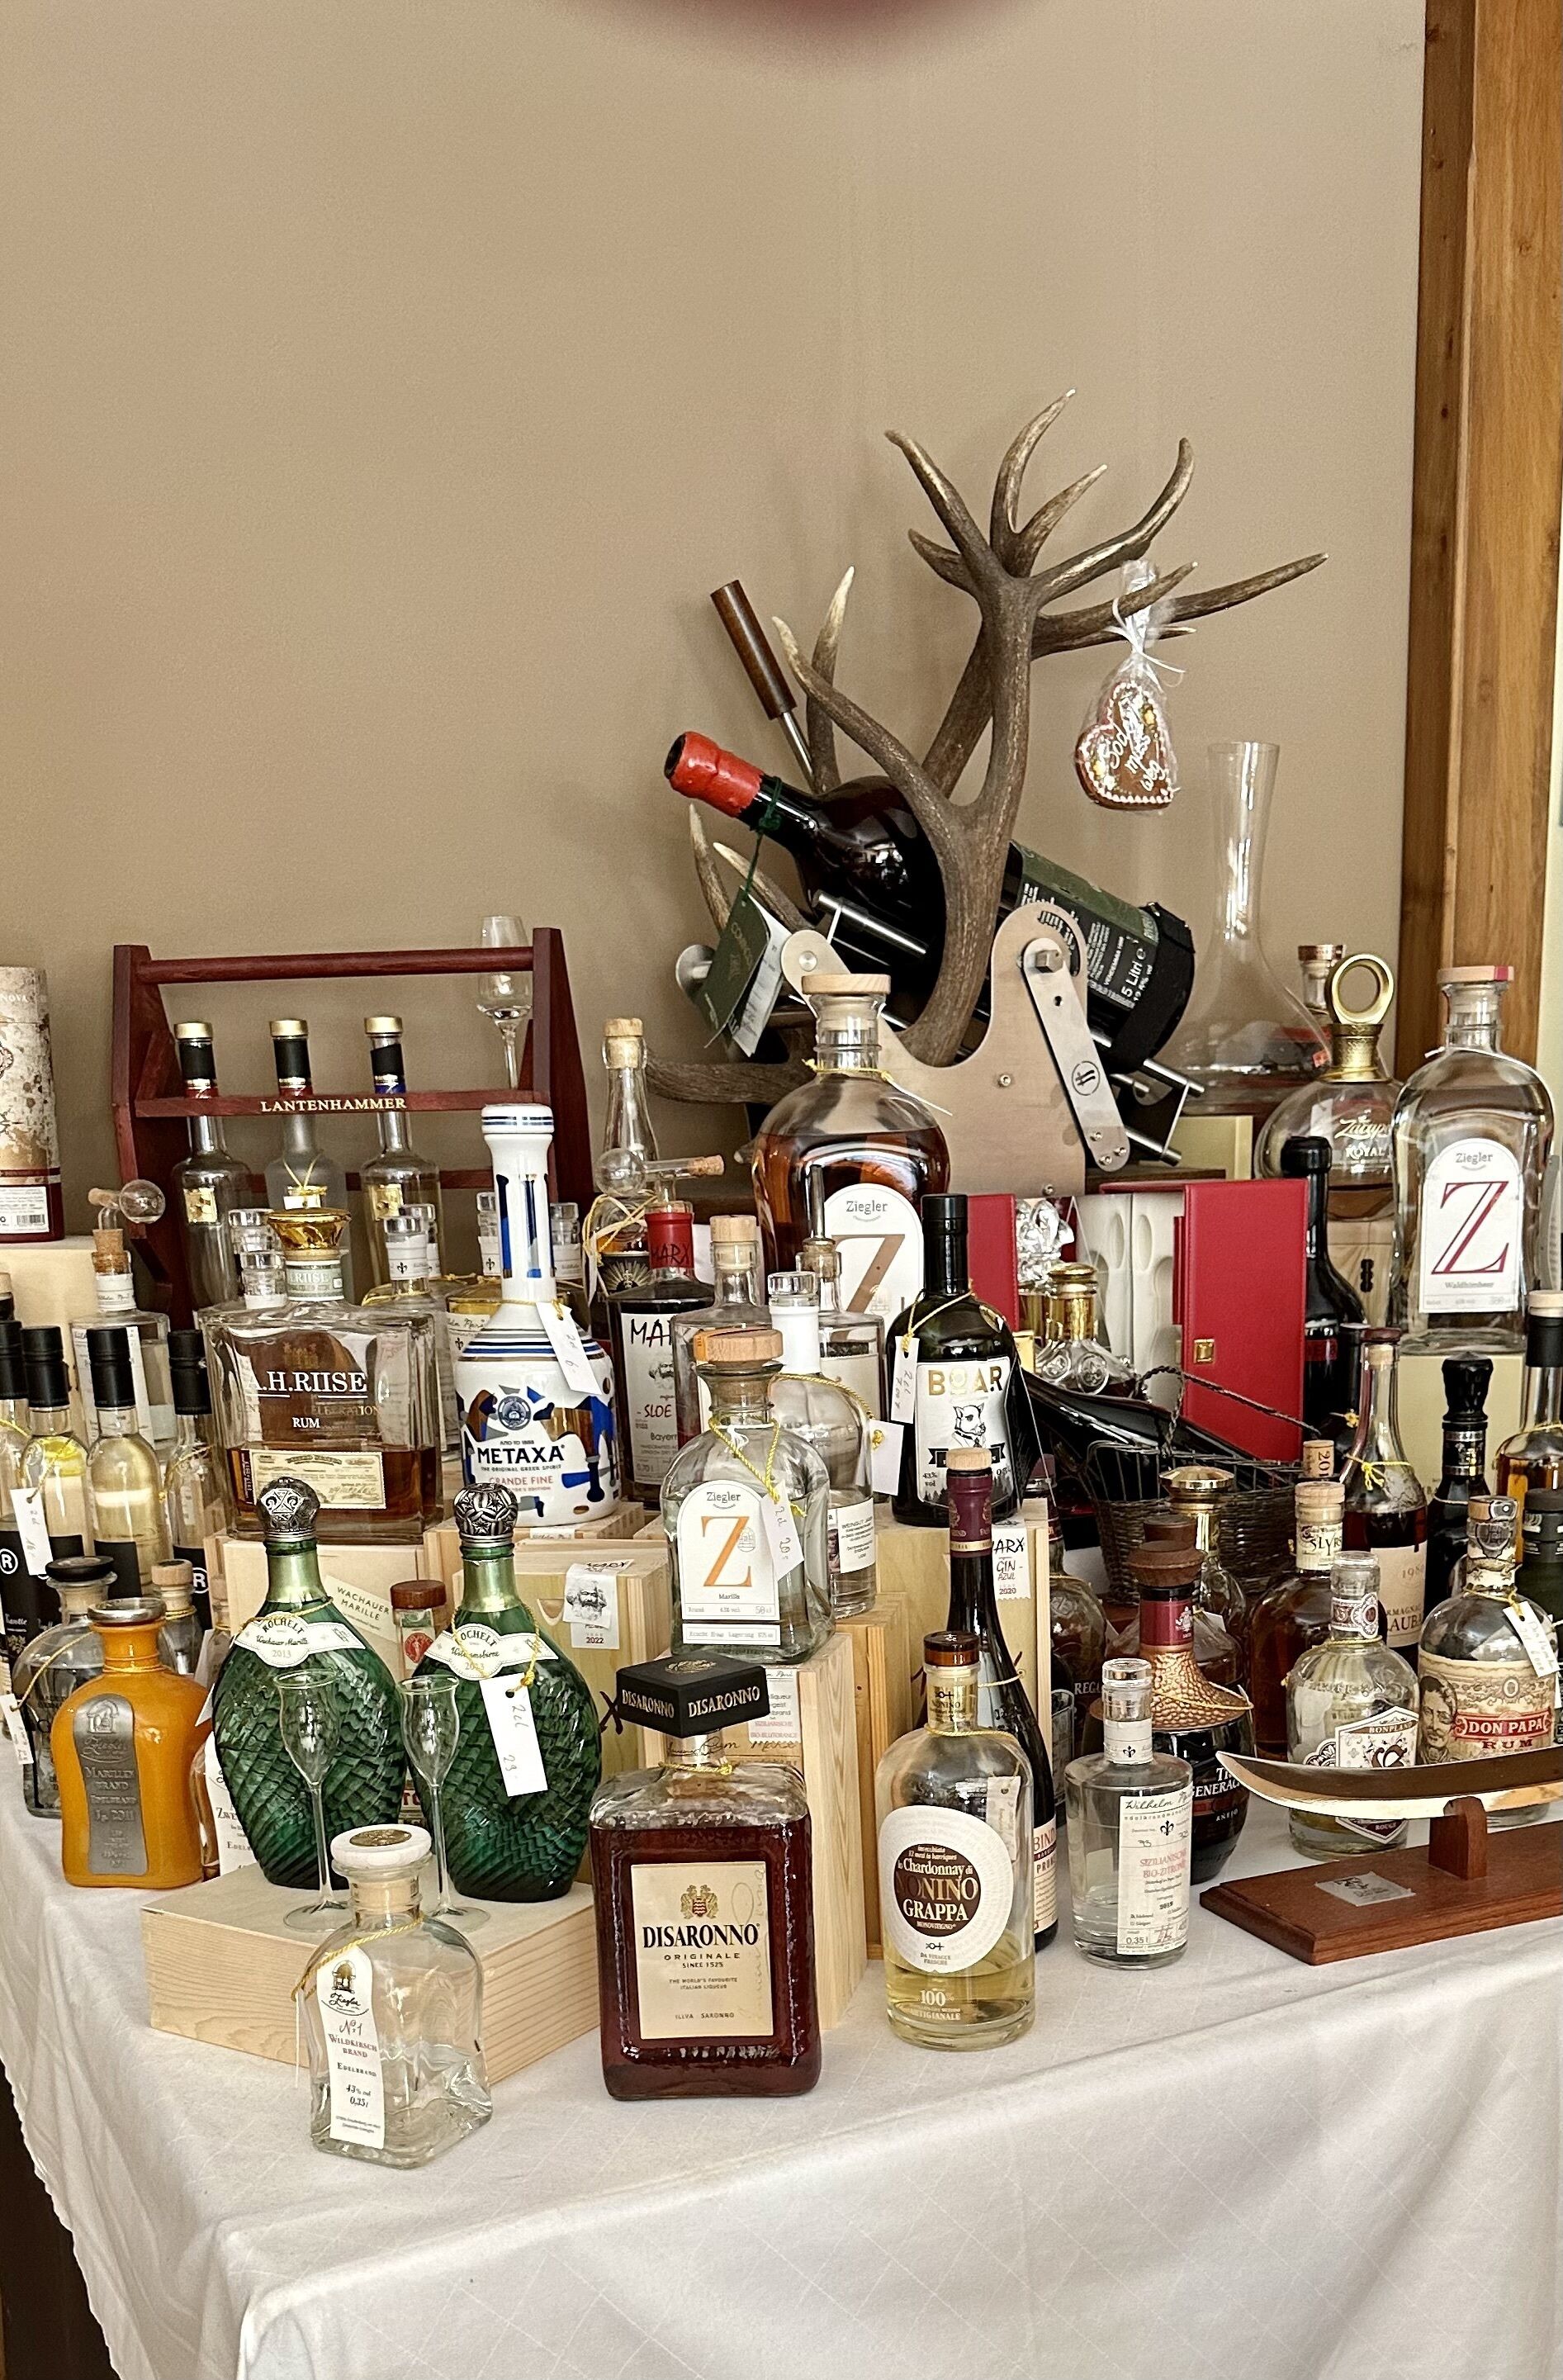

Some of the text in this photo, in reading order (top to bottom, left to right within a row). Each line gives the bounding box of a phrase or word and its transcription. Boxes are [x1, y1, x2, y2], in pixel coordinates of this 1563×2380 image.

[1139, 759, 1166, 792] weg
[1125, 960, 1143, 986] Litri
[1121, 987, 1133, 998] 5
[260, 1098, 407, 1112] LANTENHAMMER
[1456, 1152, 1493, 1164] Ziegler
[845, 1200, 888, 1216] Ziegler
[1431, 1181, 1509, 1275] Z
[245, 1371, 368, 1394] A.H.RIISE
[644, 1404, 673, 1419] SLOE
[292, 1417, 321, 1429] RUM
[476, 1445, 565, 1465] METAXA
[489, 1475, 554, 1486] GRANDE FINE
[706, 1491, 741, 1504] Ziegler
[700, 1515, 753, 1588] Z
[996, 1560, 1016, 1574] GIN
[337, 1586, 390, 1615] WACHAUER
[340, 1598, 381, 1621] MARILLE
[263, 1615, 305, 1634] ROCHELT
[457, 1629, 498, 1647] OCHELT
[585, 1636, 604, 1644] 2022
[272, 1648, 291, 1659] 2013
[1074, 1681, 1102, 1695] REGA
[622, 1685, 761, 1719] DISARONNO DISARONNO
[1469, 1715, 1544, 1734] DON PAPA
[1481, 1738, 1533, 1750] RUM
[903, 1857, 966, 1880] Chardonnay
[965, 1865, 973, 1875] di
[902, 1899, 969, 1922] GRAPPA
[642, 1923, 759, 1949] DISARONNO
[663, 1952, 741, 1961] ORIGINALE
